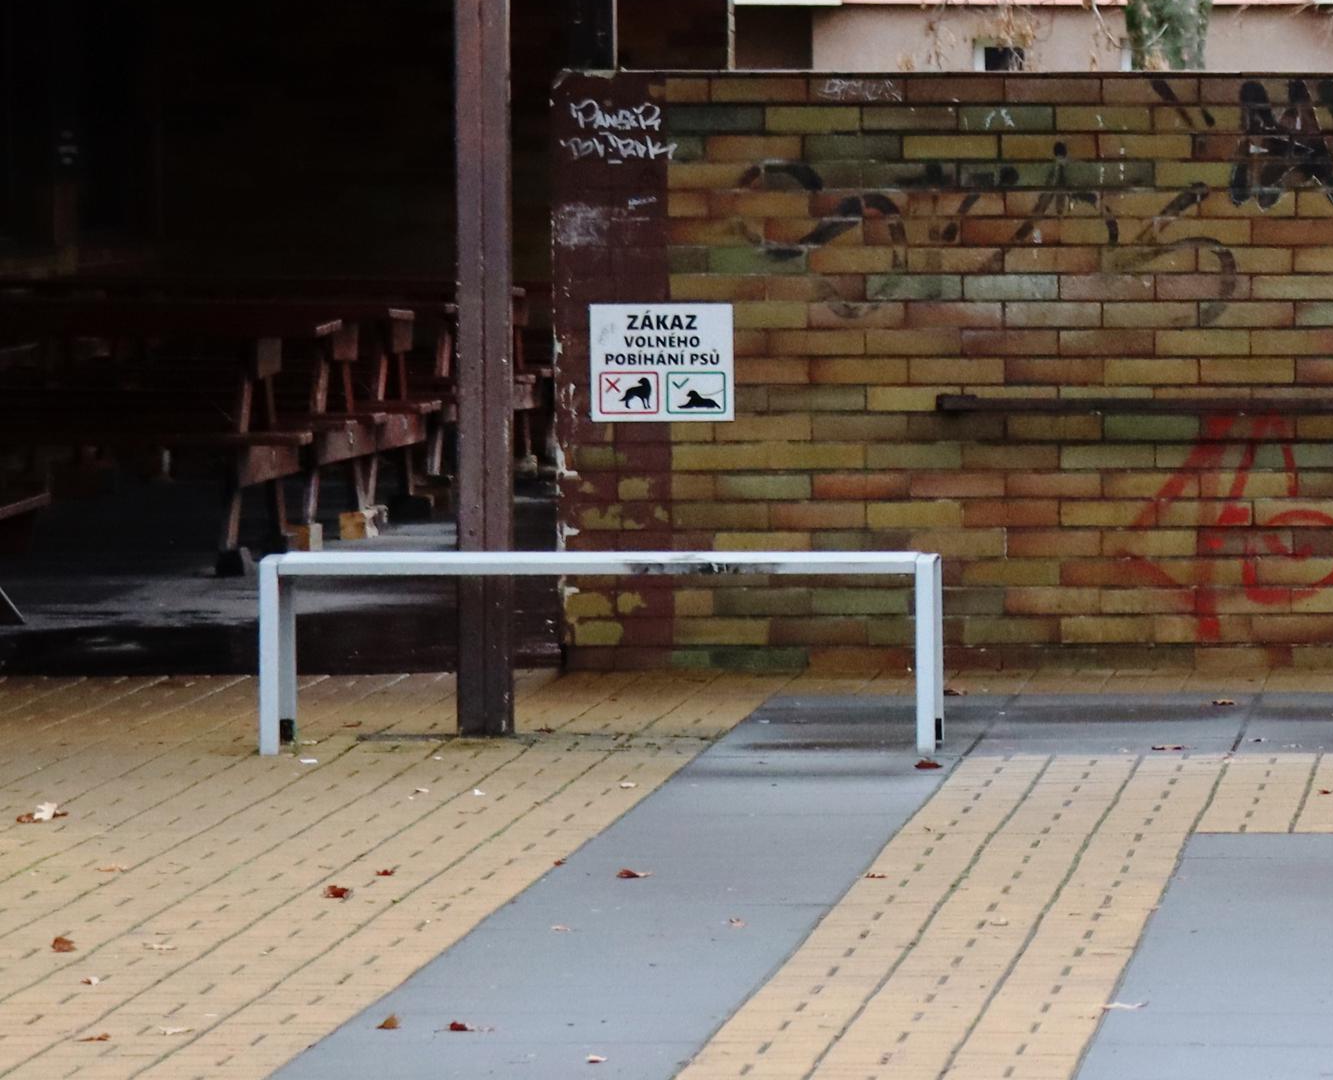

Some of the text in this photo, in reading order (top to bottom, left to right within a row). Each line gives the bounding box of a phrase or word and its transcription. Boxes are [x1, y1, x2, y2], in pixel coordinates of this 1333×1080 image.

[627, 309, 697, 331] ZÁKAZ
[624, 333, 700, 348] VOLNÉHO
[604, 348, 720, 366] POBÍHÁNÍ PSŮ
